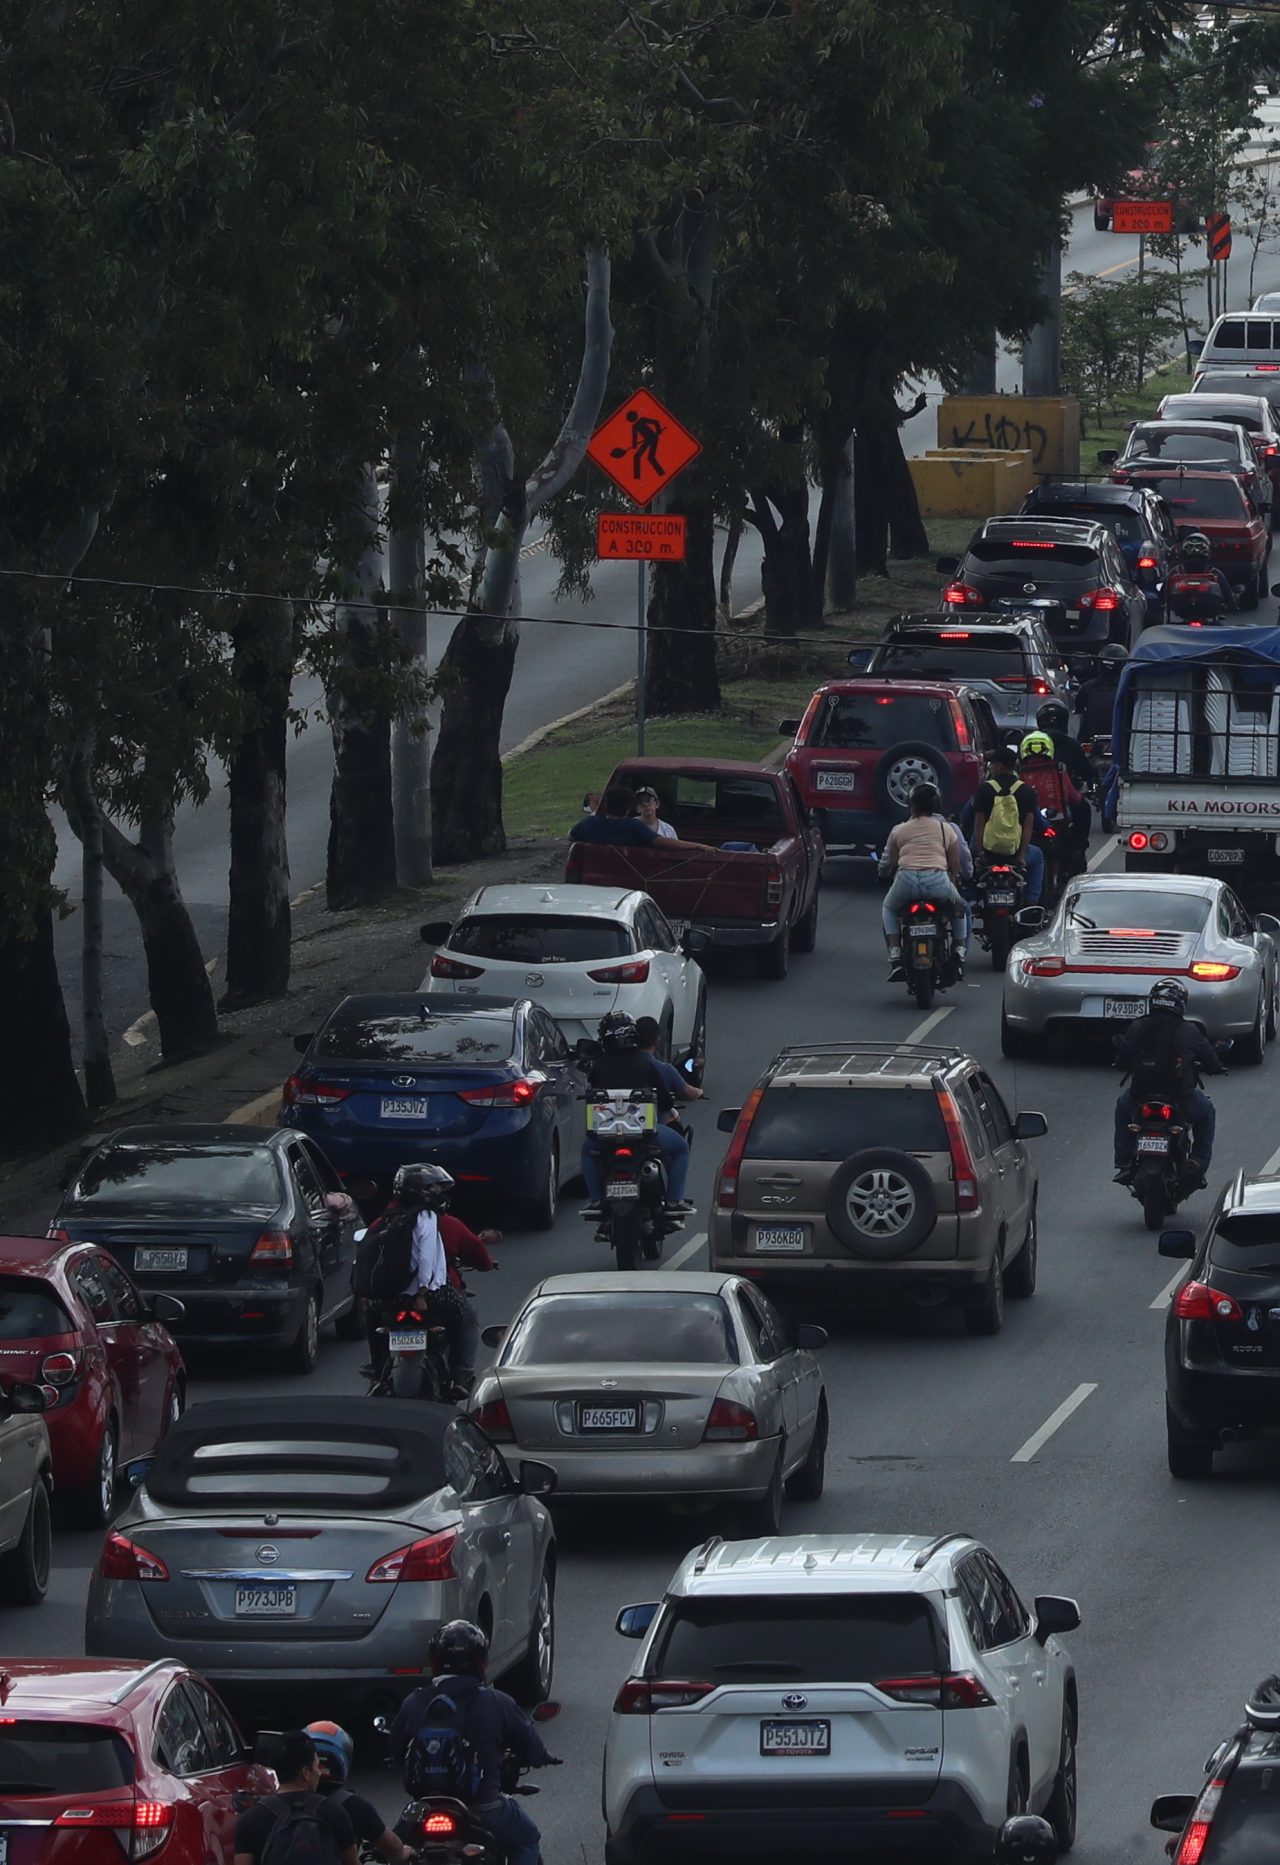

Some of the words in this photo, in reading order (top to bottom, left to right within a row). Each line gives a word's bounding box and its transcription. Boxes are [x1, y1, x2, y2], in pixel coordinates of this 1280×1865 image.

[1121, 221, 1126, 229] A
[601, 520, 681, 536] CONSTRUCCION
[608, 540, 618, 553] A
[626, 540, 652, 554] 300
[1168, 801, 1198, 813] KIA
[1204, 801, 1280, 815] MOTORS
[1106, 1002, 1144, 1014] P493DPS
[761, 1196, 796, 1204] CR-V
[758, 1232, 802, 1245] P936KBQ
[583, 1409, 635, 1427] P665FCY
[237, 1591, 293, 1607] P973JPB
[764, 1727, 828, 1747] P551JTZ
